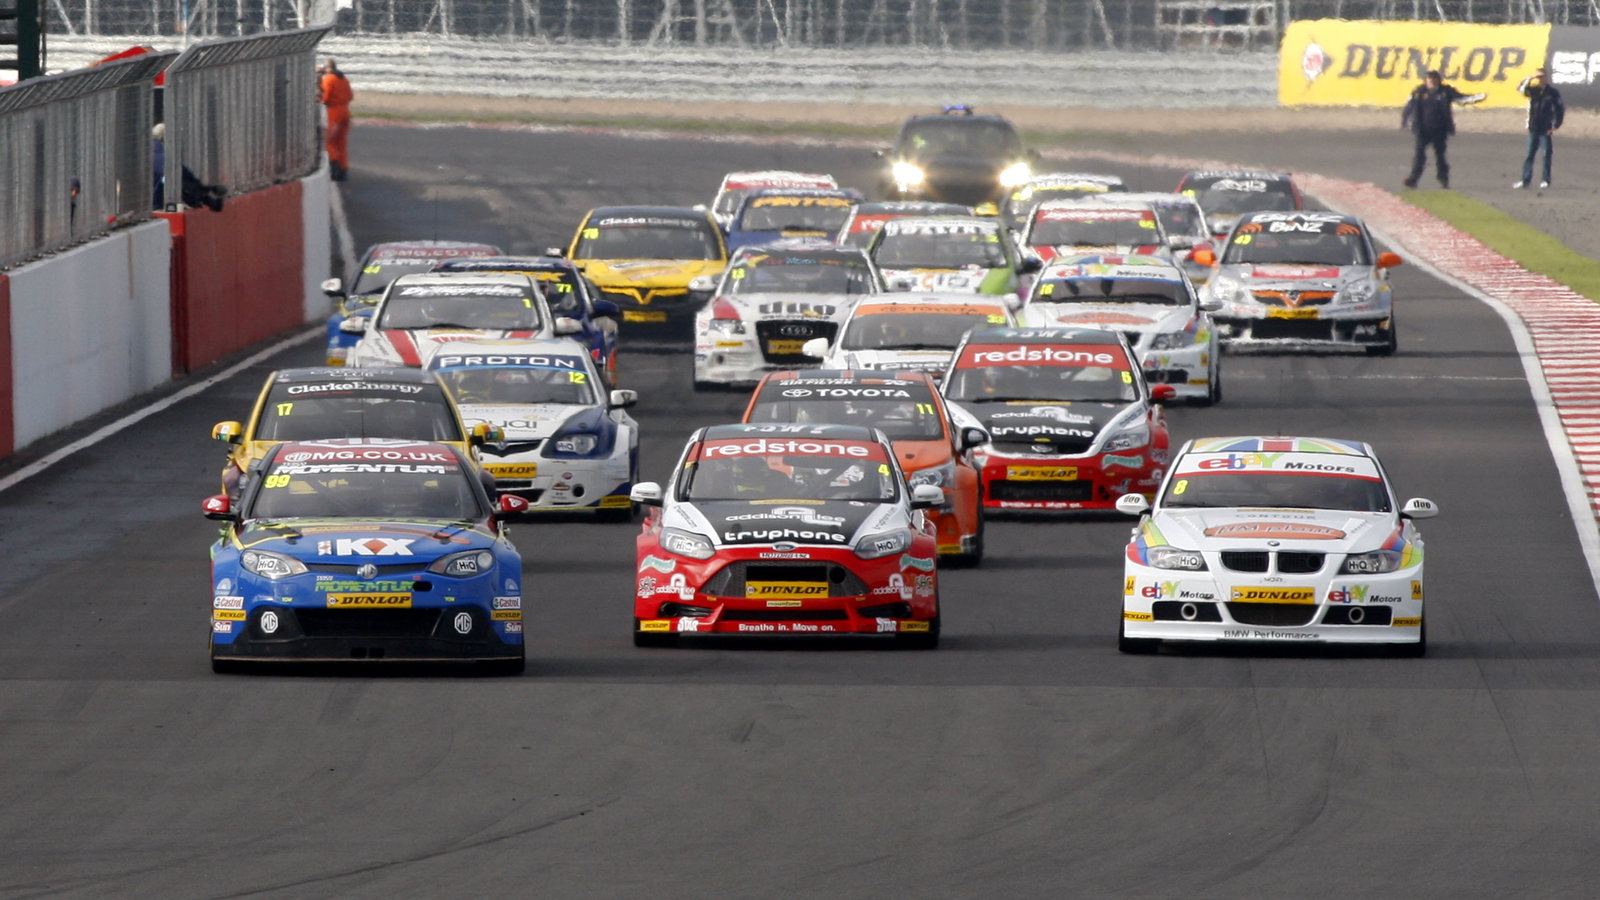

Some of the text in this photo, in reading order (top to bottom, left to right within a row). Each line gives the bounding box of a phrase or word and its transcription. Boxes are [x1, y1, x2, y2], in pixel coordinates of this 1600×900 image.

[1338, 43, 1526, 81] DUNLOP
[974, 345, 1114, 363] redstone
[440, 356, 575, 369] PROTON
[568, 371, 585, 384] 12
[816, 388, 910, 397] TOYOTA
[276, 402, 294, 416] 17
[916, 403, 934, 415] 11
[991, 425, 1094, 438] truphone
[705, 438, 869, 457] redstone
[312, 450, 448, 461] MG.CO.UK
[274, 463, 446, 475] MOMENTUM
[878, 463, 890, 476] 4
[1284, 461, 1356, 474] Motors
[1018, 469, 1077, 478] DUNLOP
[264, 474, 291, 488] 99
[1173, 479, 1188, 495] 8
[725, 512, 796, 523] addison
[725, 528, 847, 543] truphone
[459, 560, 476, 570] HiQ
[1180, 556, 1199, 566] HiQ
[1349, 560, 1367, 570] HiQ
[315, 580, 416, 592] MOMENTUM
[759, 585, 828, 595] DUNLOP
[341, 596, 411, 605] DUNLOP
[1245, 591, 1313, 600] DUNLOP
[1369, 595, 1402, 603] Motors
[220, 597, 241, 608] Castrol
[499, 597, 521, 607] Castrol
[214, 623, 231, 632] Sun
[506, 622, 522, 632] Sun
[738, 623, 836, 632] Breathe in. Move on.
[1224, 630, 1320, 640] BMW Performance
